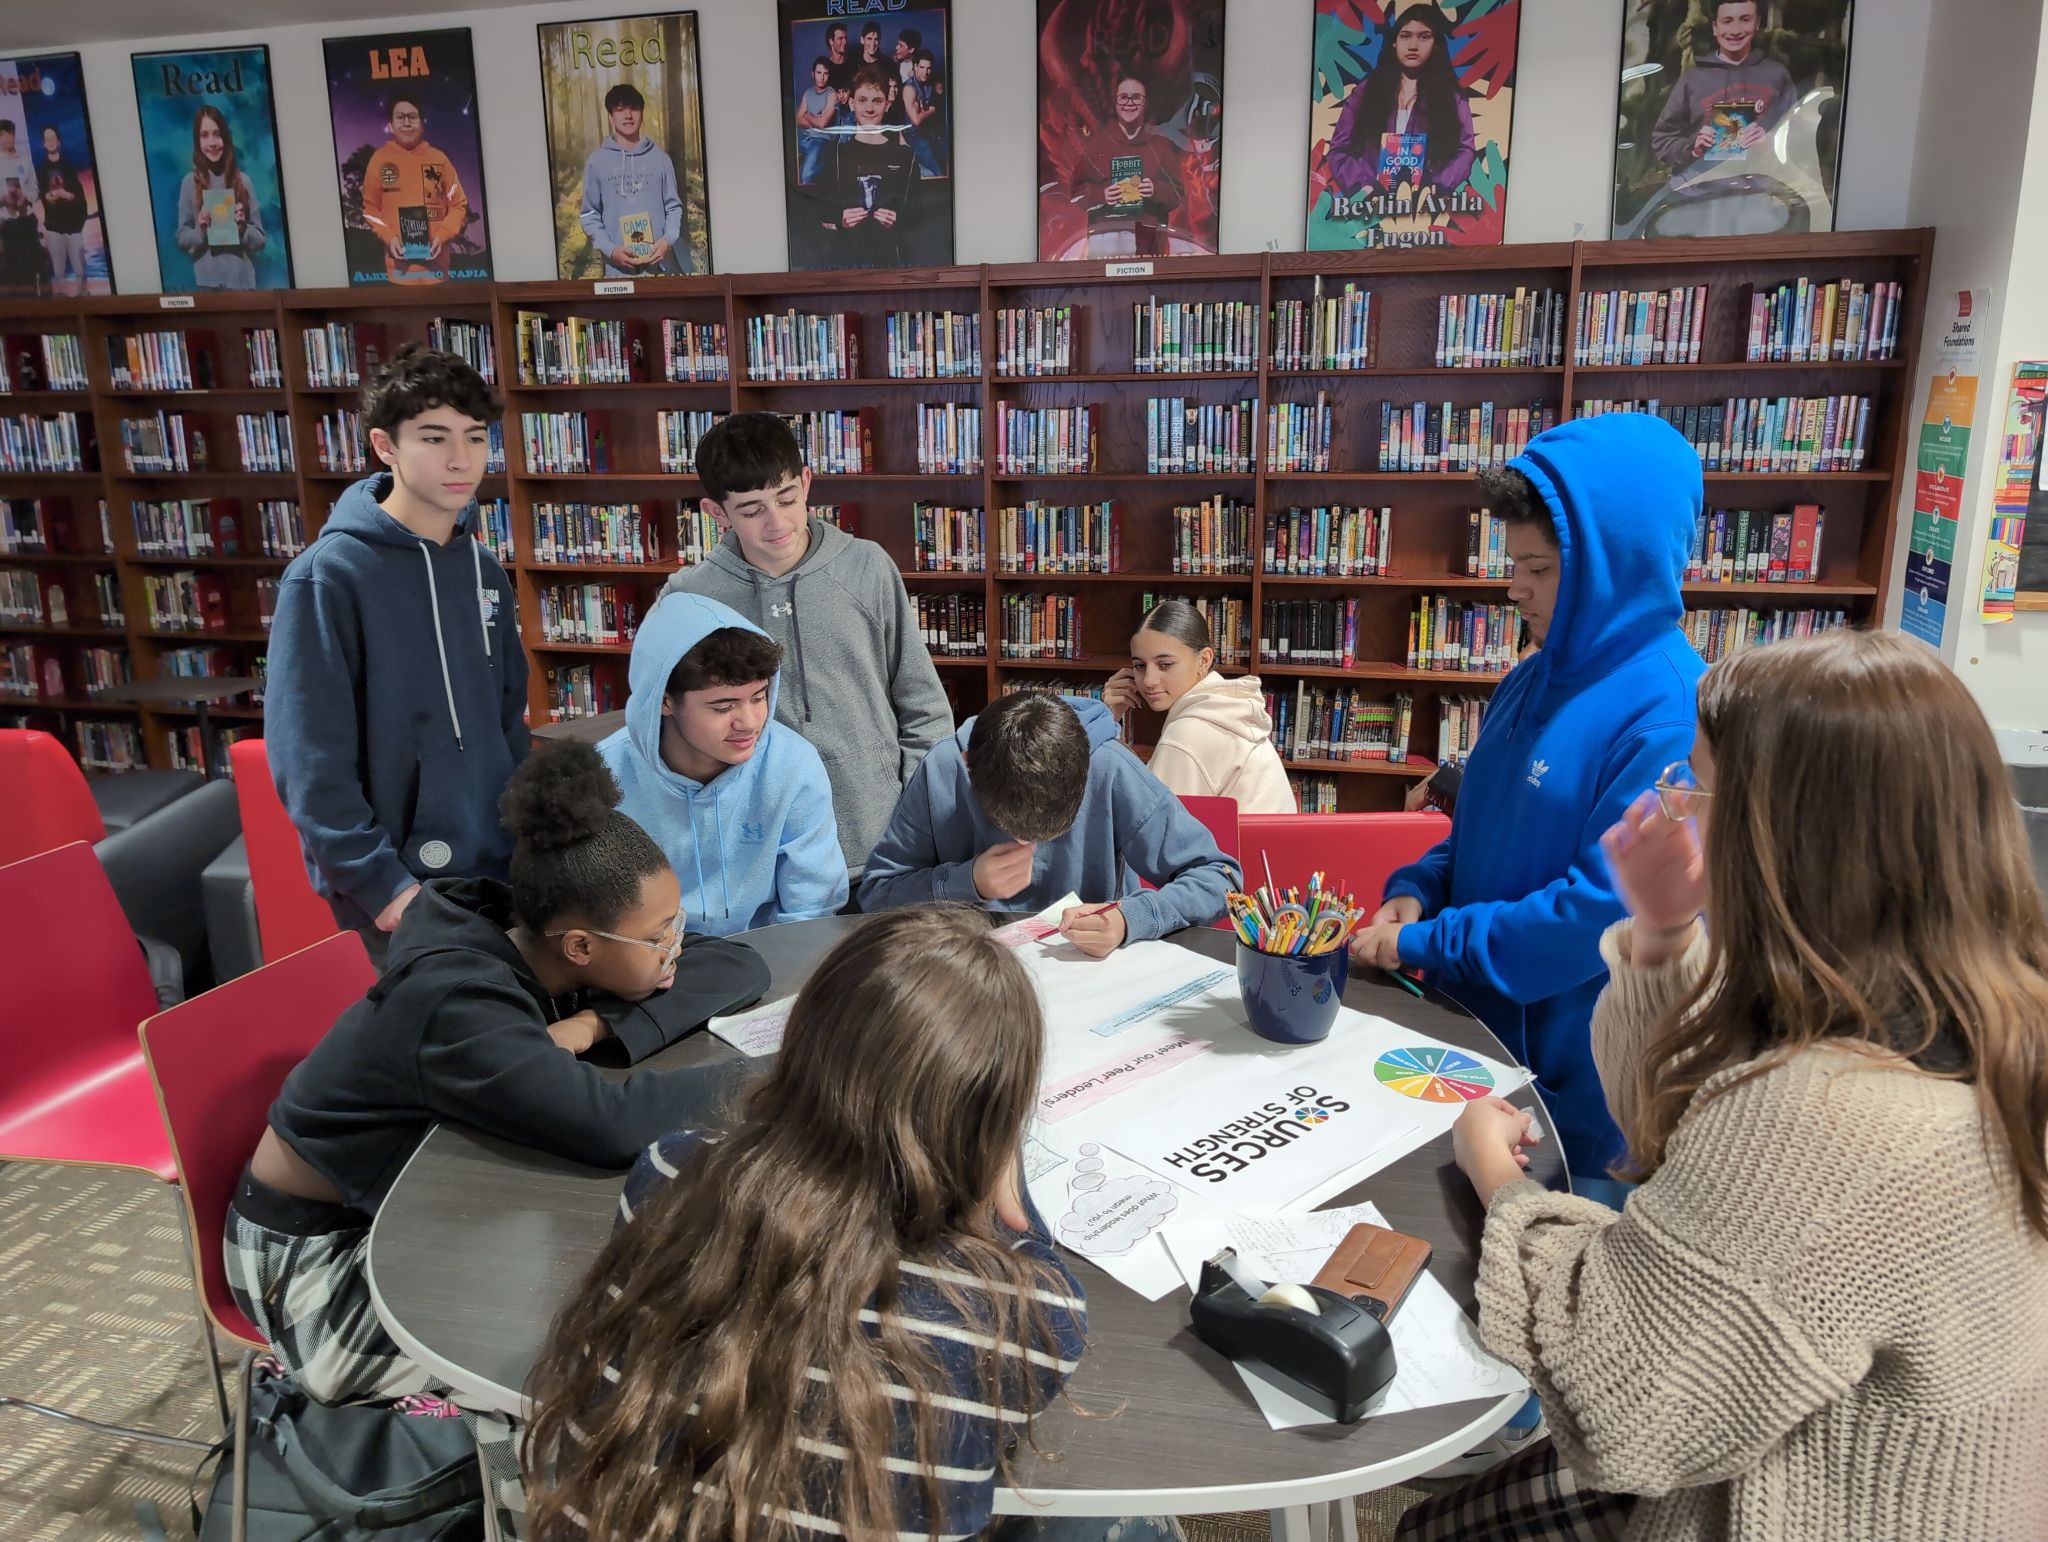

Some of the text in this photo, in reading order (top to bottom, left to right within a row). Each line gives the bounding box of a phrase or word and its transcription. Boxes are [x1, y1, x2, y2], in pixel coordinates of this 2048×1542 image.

[827, 0, 907, 16] READ
[571, 31, 668, 70] Read
[369, 45, 430, 80] LEA
[161, 58, 244, 97] Read
[1386, 156, 1419, 166] GOOD
[1397, 146, 1409, 156] IN
[1333, 191, 1483, 221] Beylin Avila
[623, 219, 649, 235] CAMP
[1367, 227, 1445, 249] Fugon
[1116, 266, 1146, 275] FICTION
[603, 286, 628, 294] FICTION
[1952, 320, 1972, 333] Shared
[1943, 335, 1975, 347] Foundations
[1041, 1039, 1190, 1108] Meet our Peer Leaders!
[1285, 1085, 1318, 1106] OF
[1163, 1102, 1288, 1169] STRENGTH
[1083, 1192, 1161, 1241] What does leadership
[1084, 1194, 1132, 1227] mean to you?
